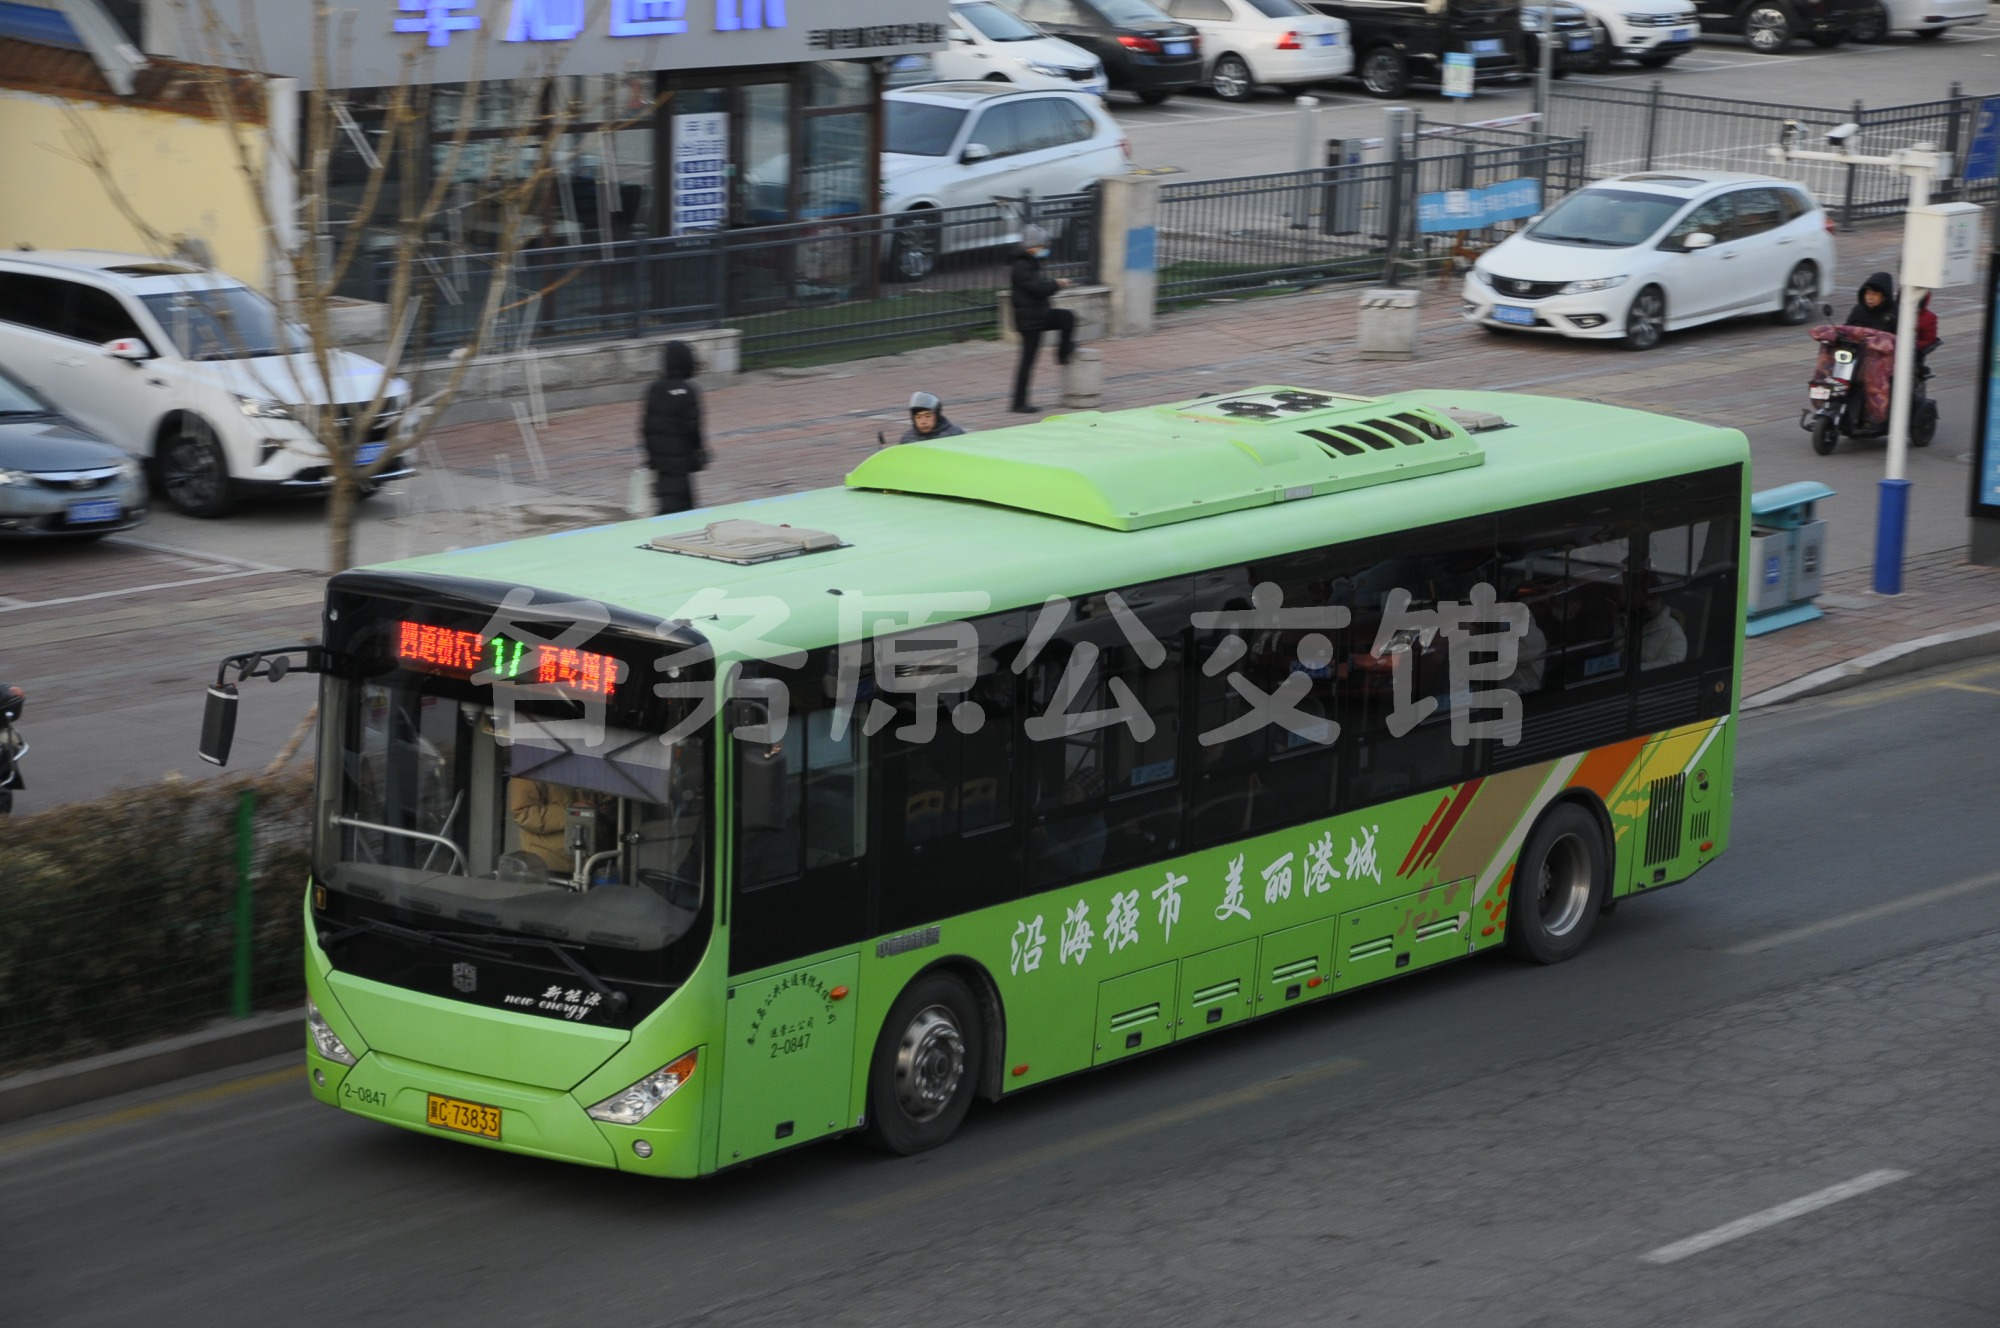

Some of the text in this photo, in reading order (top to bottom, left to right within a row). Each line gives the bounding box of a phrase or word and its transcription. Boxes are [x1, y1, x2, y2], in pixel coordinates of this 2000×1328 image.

[1010, 824, 1382, 976] 沿海强市 美丽港城
[504, 994, 588, 1021] new energy
[541, 985, 602, 1006] 新能源
[770, 1032, 811, 1059] 2-0847
[344, 1083, 387, 1107] 2-0847
